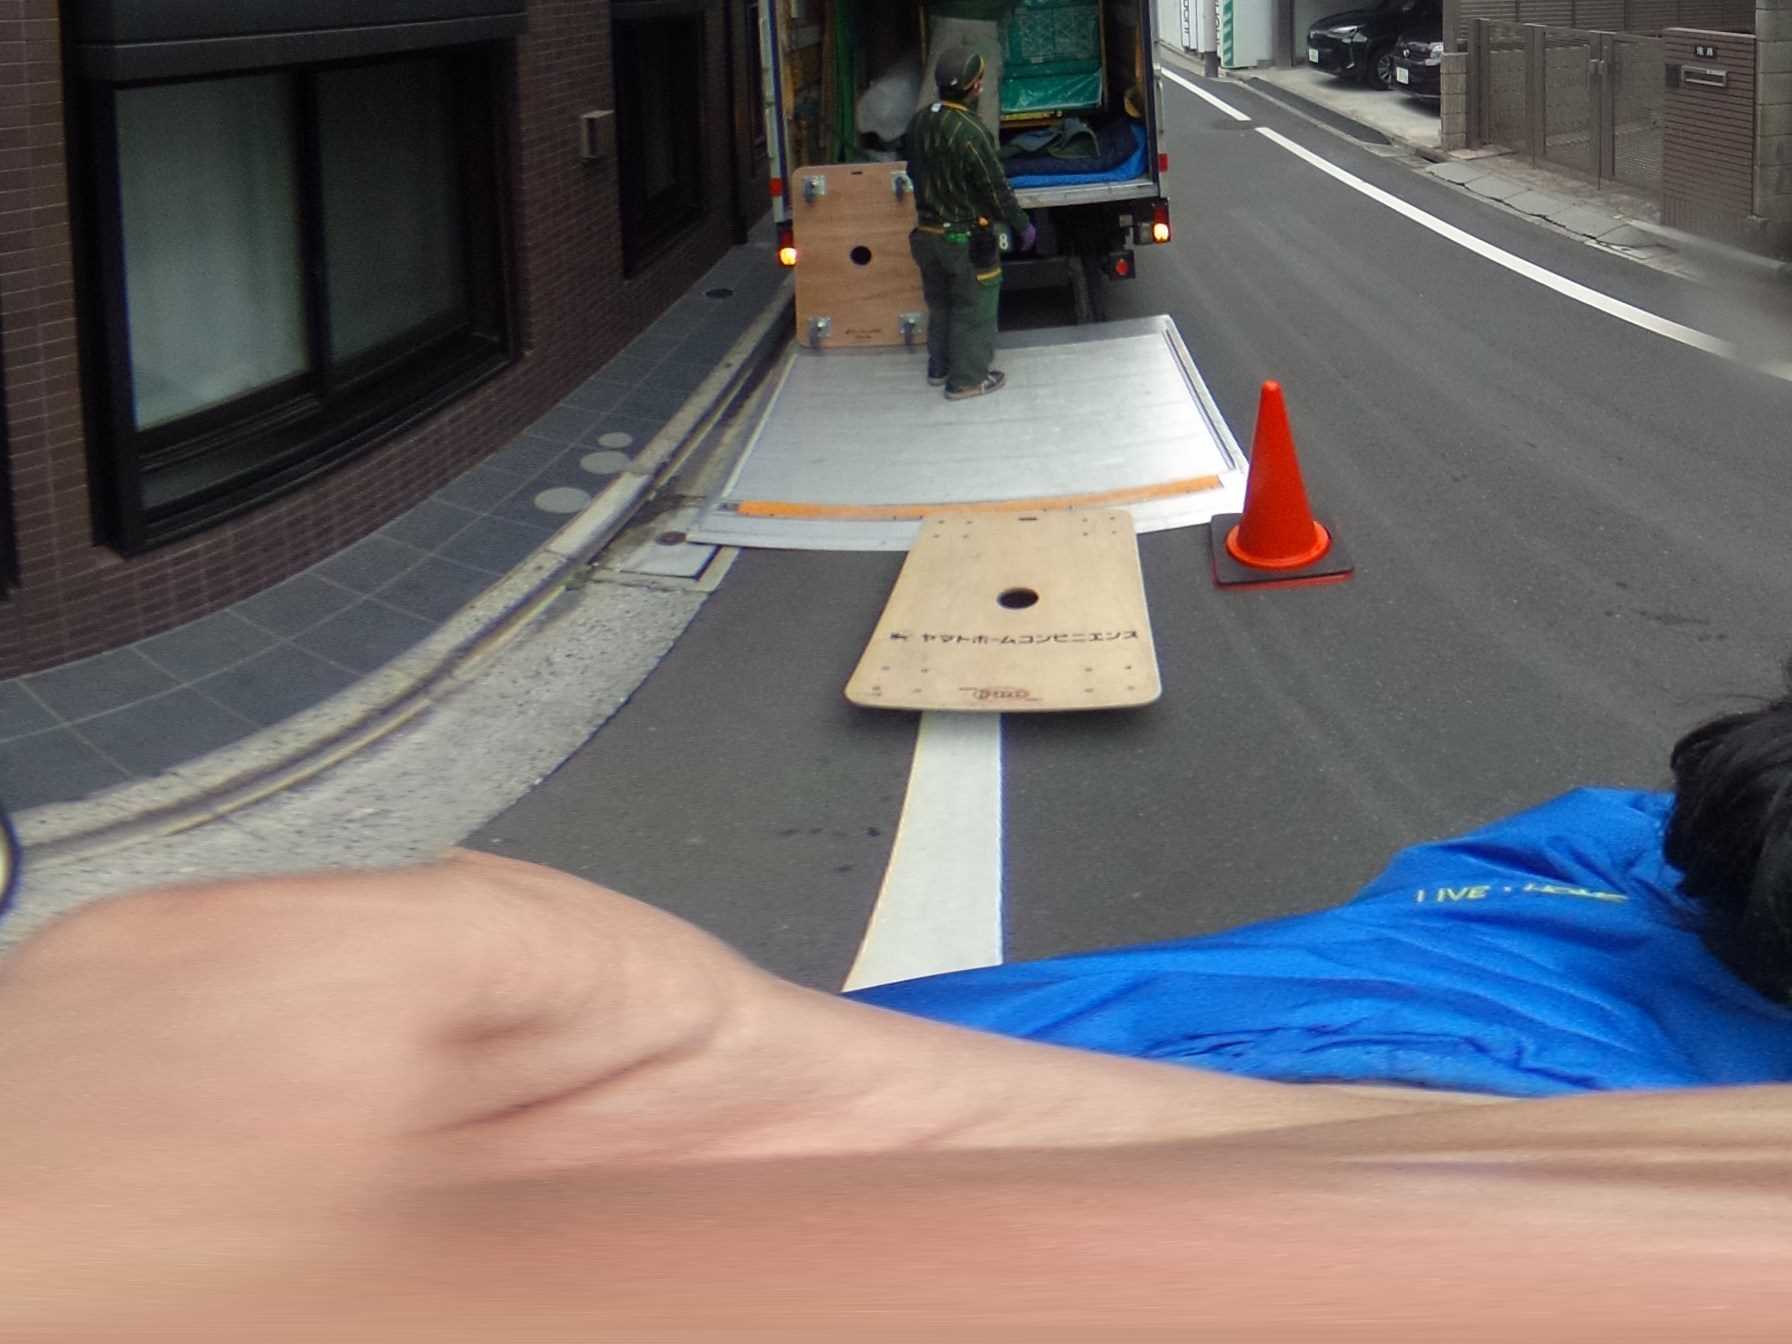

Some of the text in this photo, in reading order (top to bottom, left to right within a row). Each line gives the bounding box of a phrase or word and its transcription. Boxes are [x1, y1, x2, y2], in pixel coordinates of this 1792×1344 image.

[921, 630, 1139, 645] ヤマトホームコンビニエンス
